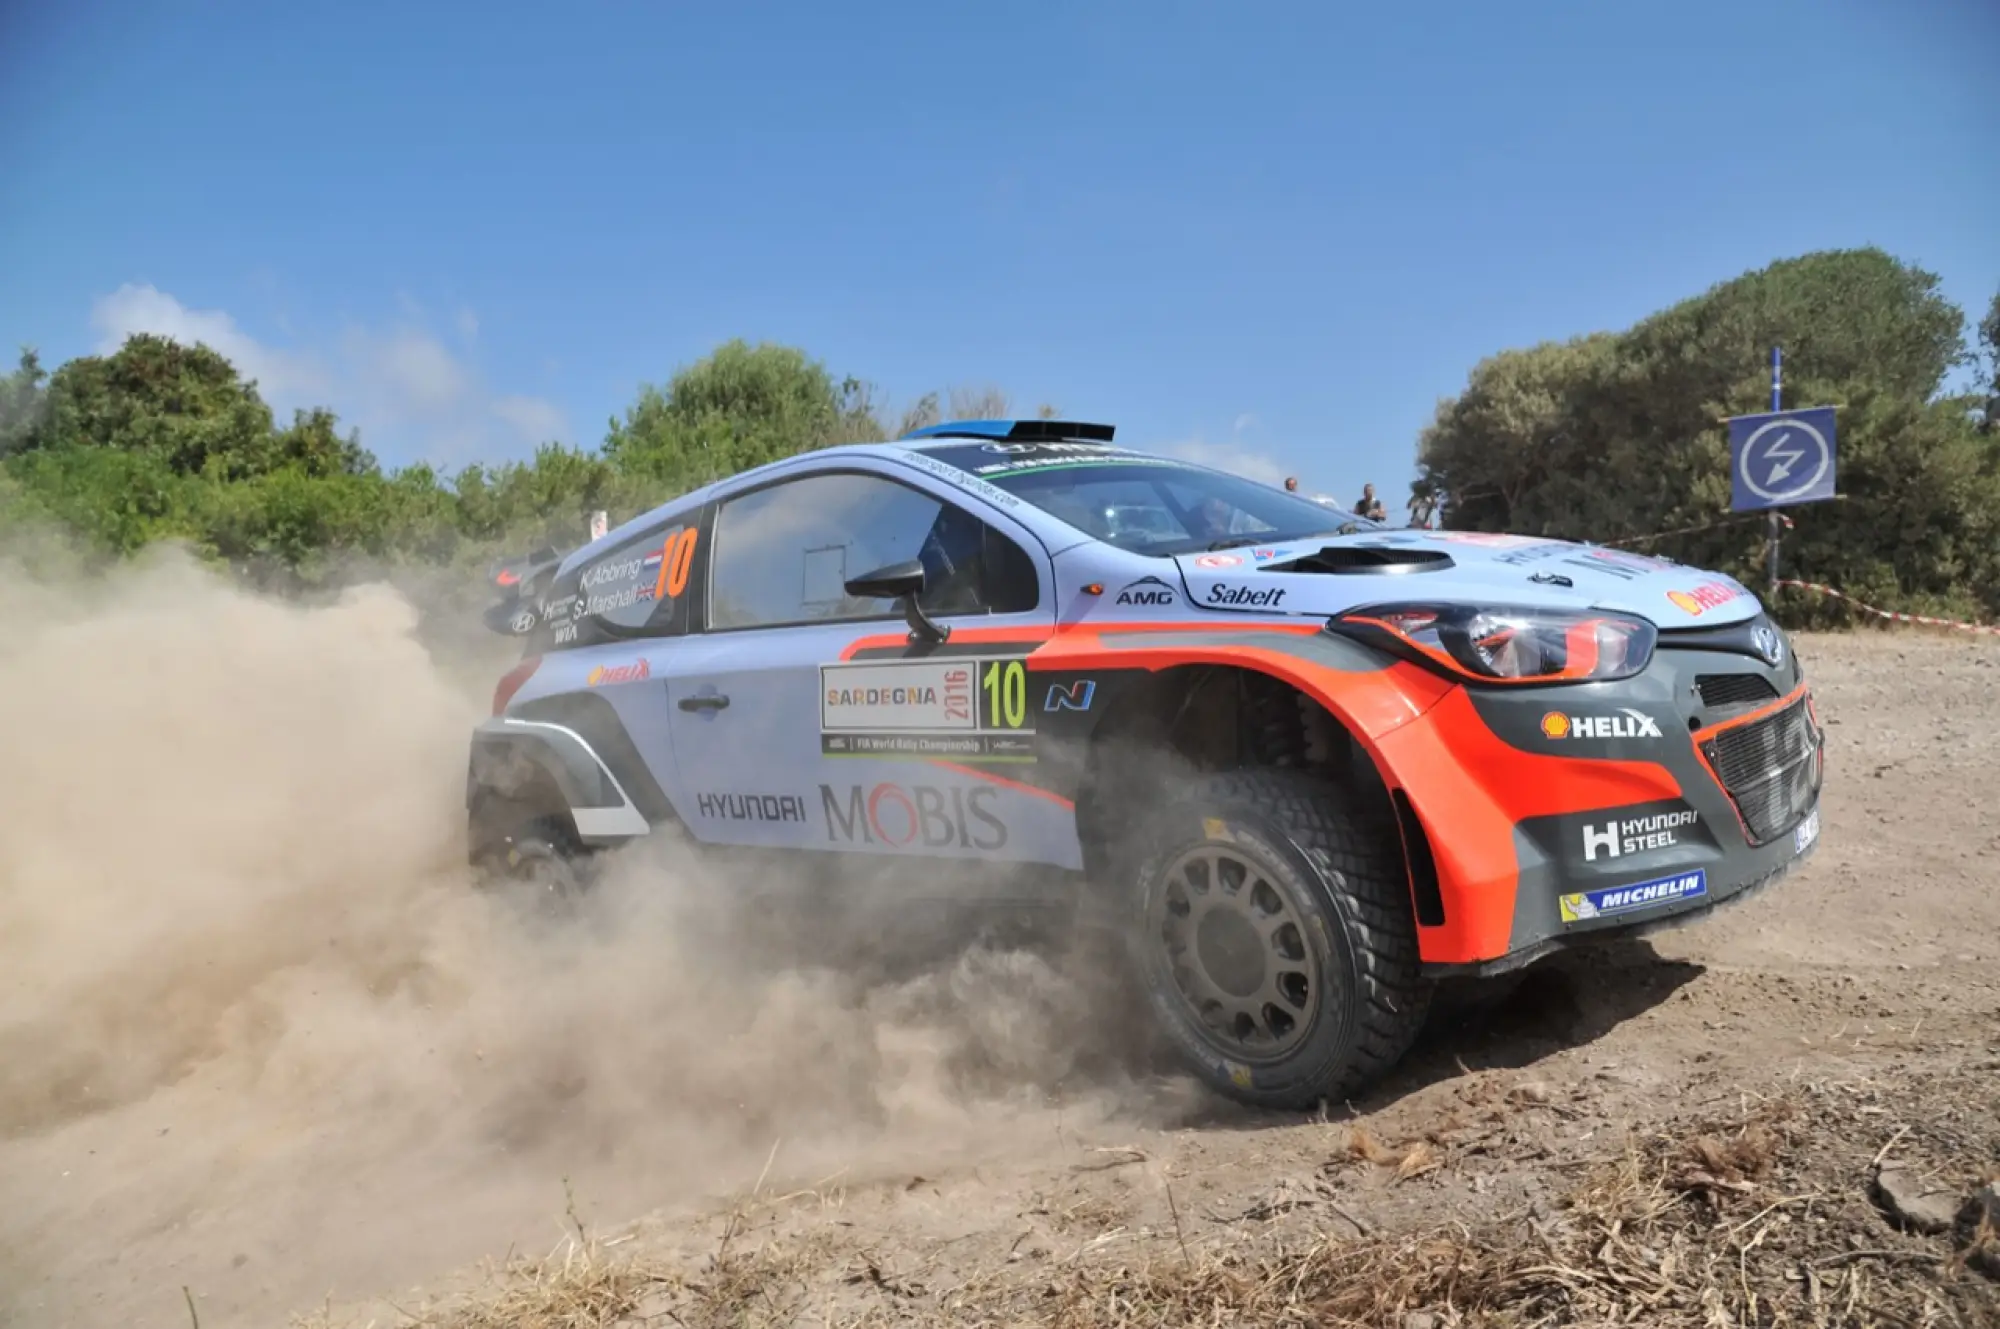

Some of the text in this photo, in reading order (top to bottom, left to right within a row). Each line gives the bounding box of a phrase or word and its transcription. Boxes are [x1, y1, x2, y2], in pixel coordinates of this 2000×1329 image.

[655, 527, 698, 599] 10
[1115, 591, 1173, 605] AMG
[1207, 583, 1286, 606] Sabelt
[828, 687, 937, 707] SARDEGNA
[944, 670, 969, 721] 2016
[984, 660, 1026, 728] 10
[1571, 708, 1663, 738] HELIX
[698, 793, 806, 822] HYUNDAI
[818, 782, 1008, 850] MOBIS
[1621, 809, 1698, 836] HYUNDAI
[1624, 831, 1677, 854] STEEL
[1602, 875, 1699, 908] MICHELIN
